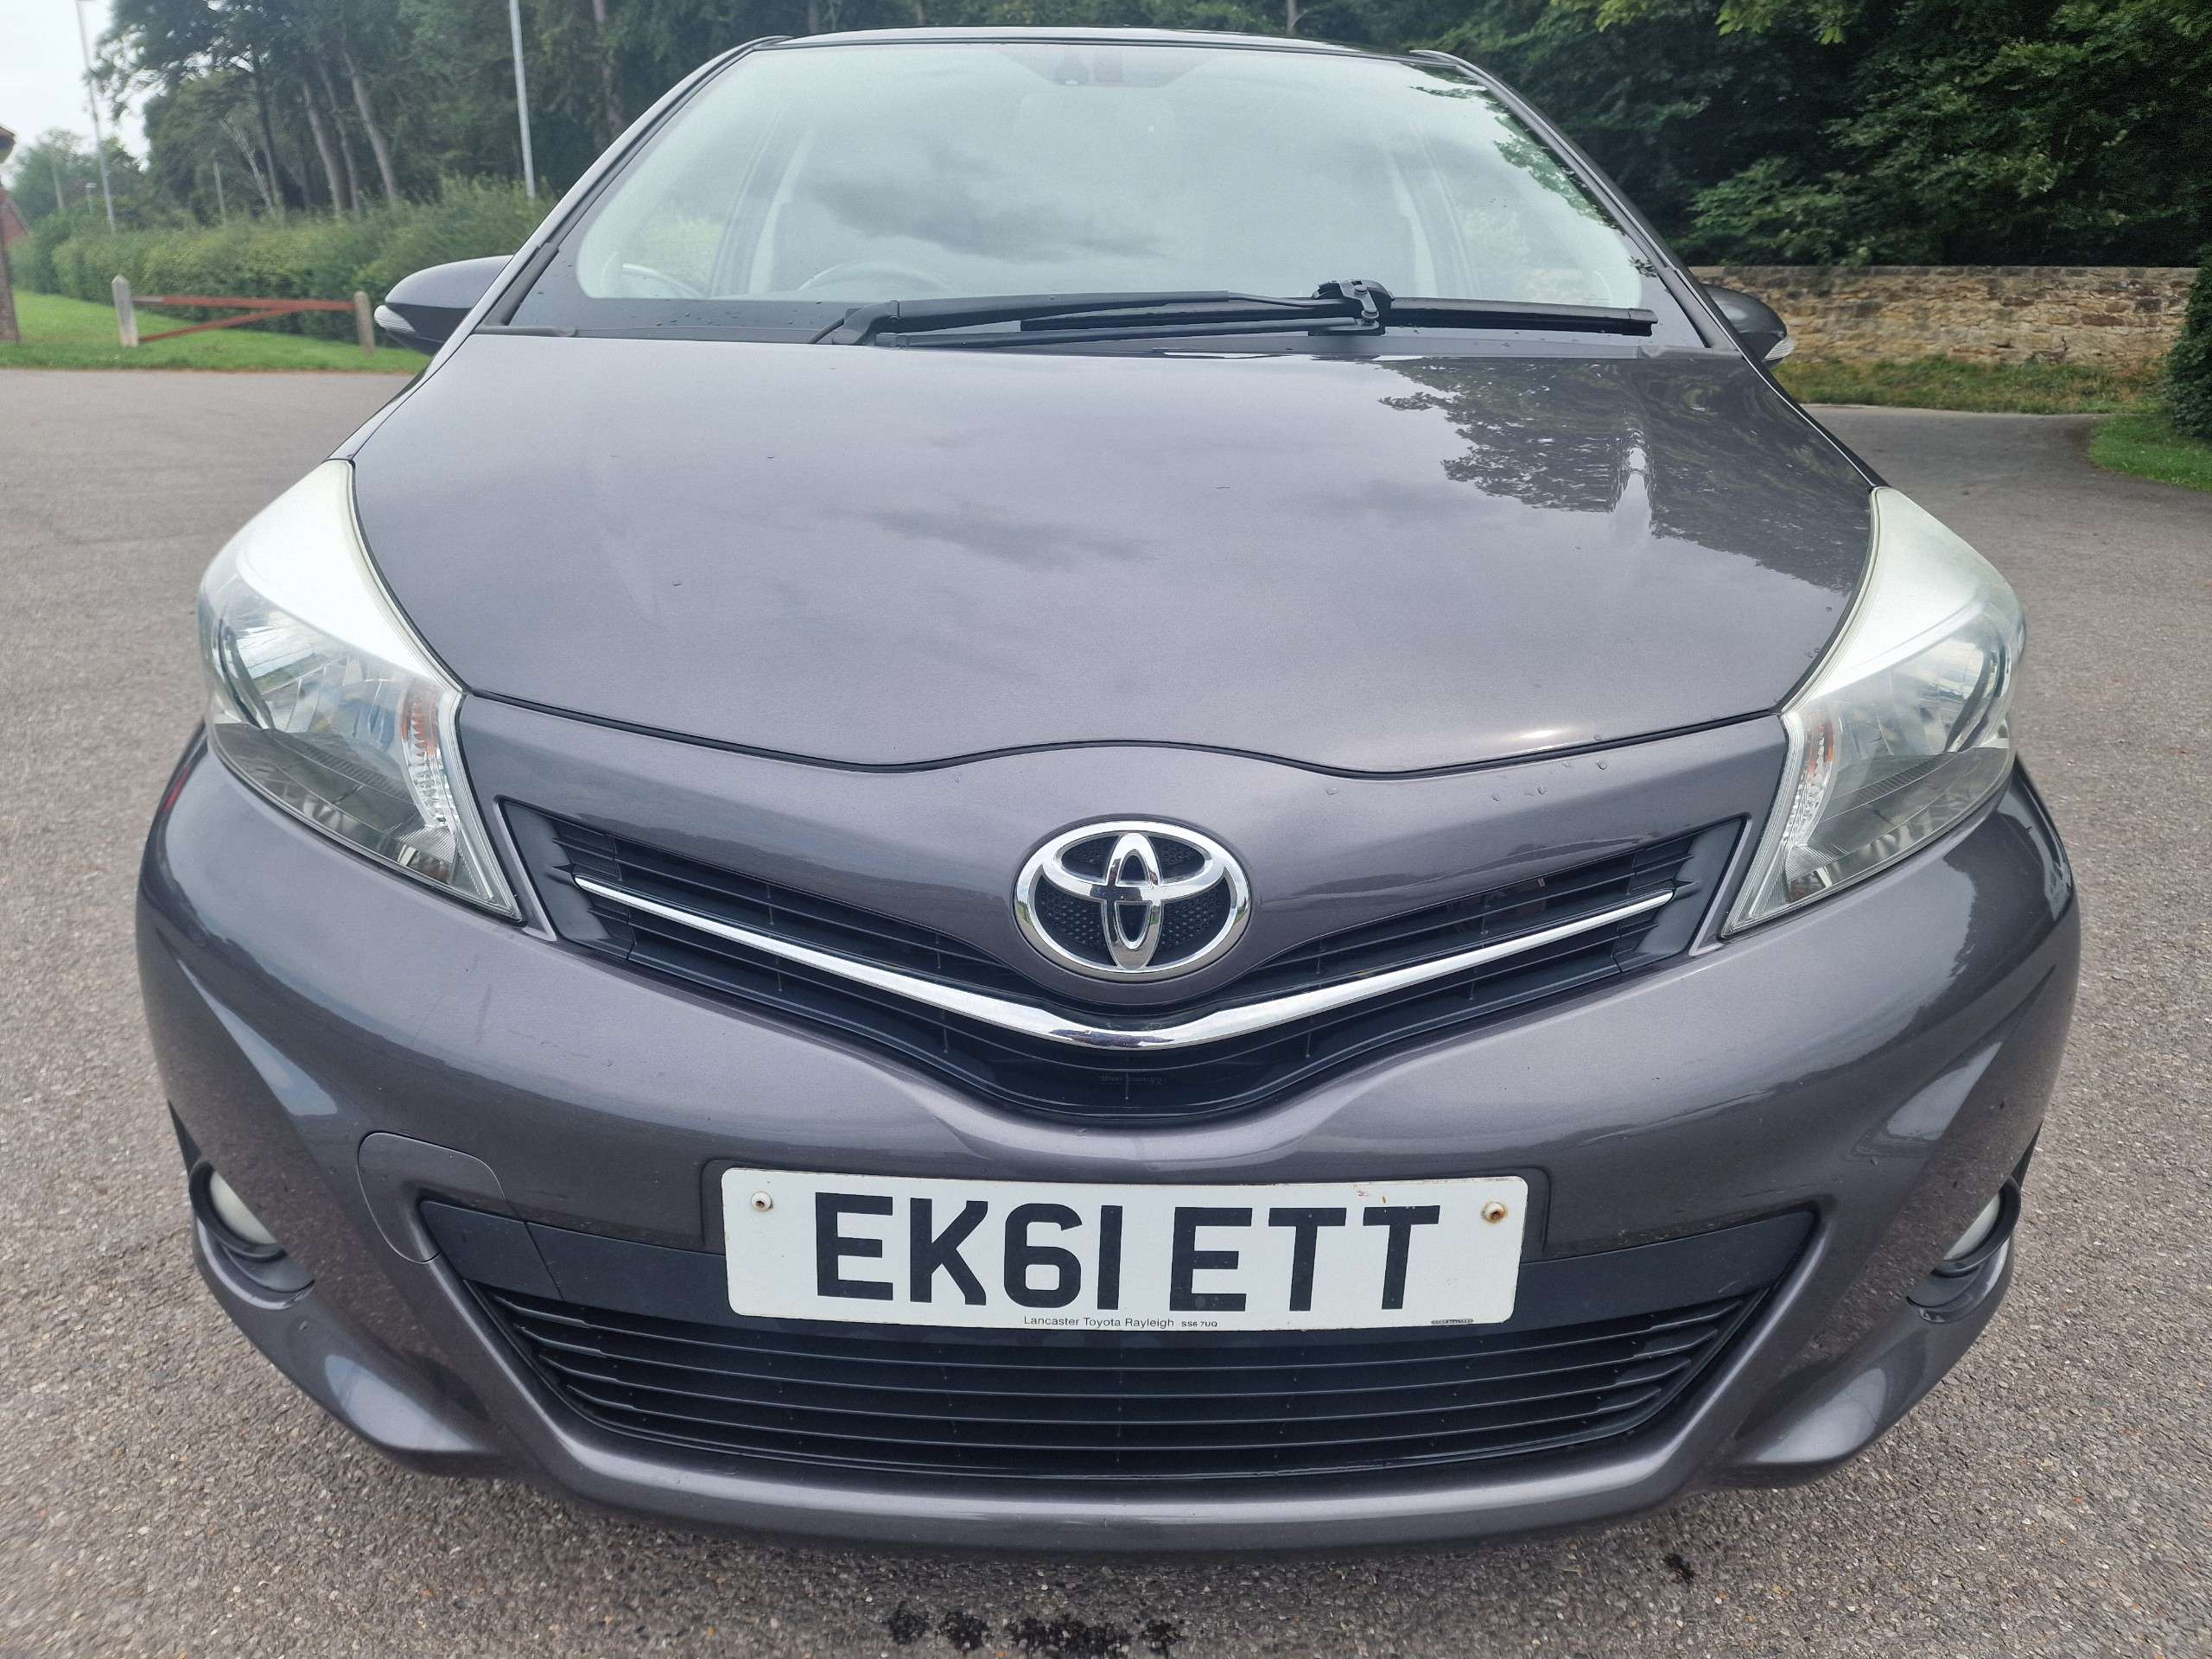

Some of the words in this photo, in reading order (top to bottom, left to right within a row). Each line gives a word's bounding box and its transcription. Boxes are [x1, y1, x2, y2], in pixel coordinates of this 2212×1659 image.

[816, 1192, 1122, 1311] EK61
[1170, 1205, 1440, 1312] ETT
[1024, 1315, 1080, 1326] Lancaster
[1084, 1317, 1122, 1329] Toyota
[1125, 1317, 1174, 1330] Rayleigh
